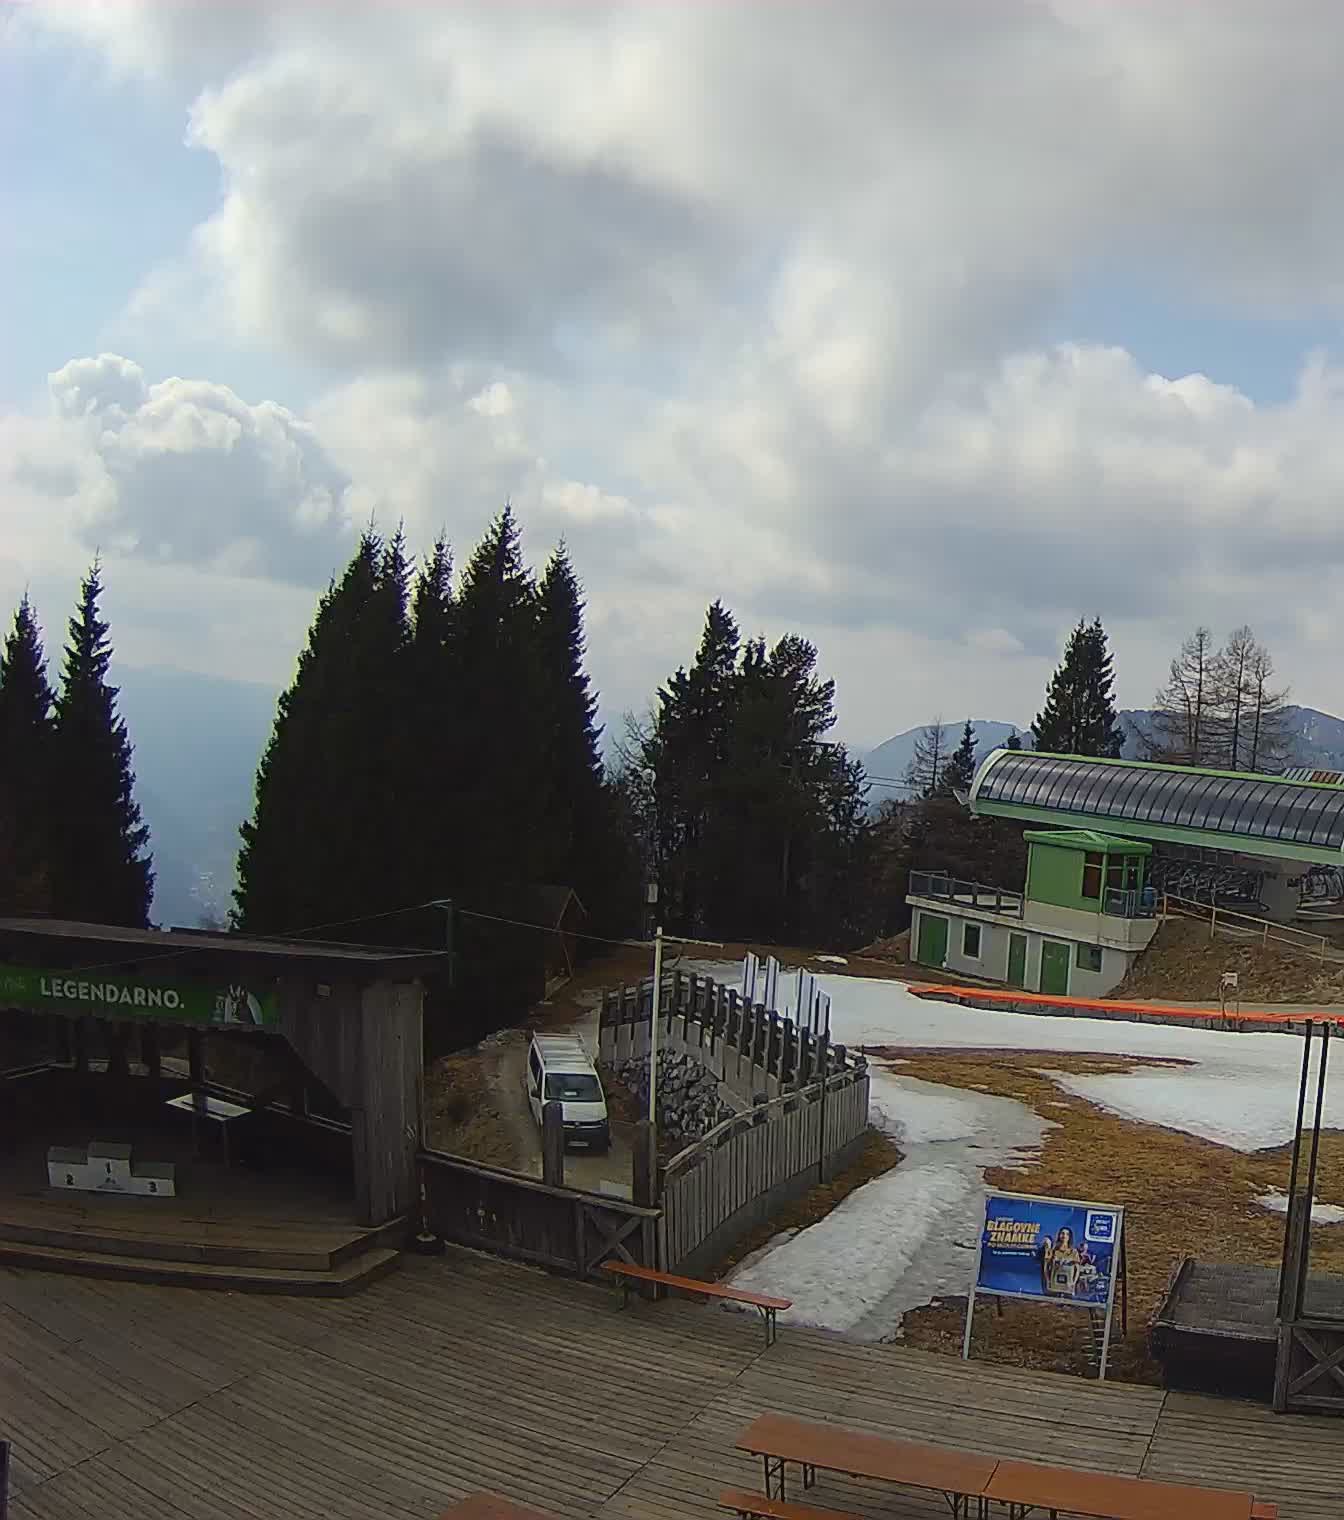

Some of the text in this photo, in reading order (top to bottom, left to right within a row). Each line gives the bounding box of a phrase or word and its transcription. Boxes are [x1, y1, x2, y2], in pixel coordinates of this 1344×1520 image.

[40, 977, 185, 1009] LEGENDARNO.
[987, 1220, 1040, 1233] BLAGOVNE
[990, 1232, 1035, 1242] ZNAMKE
